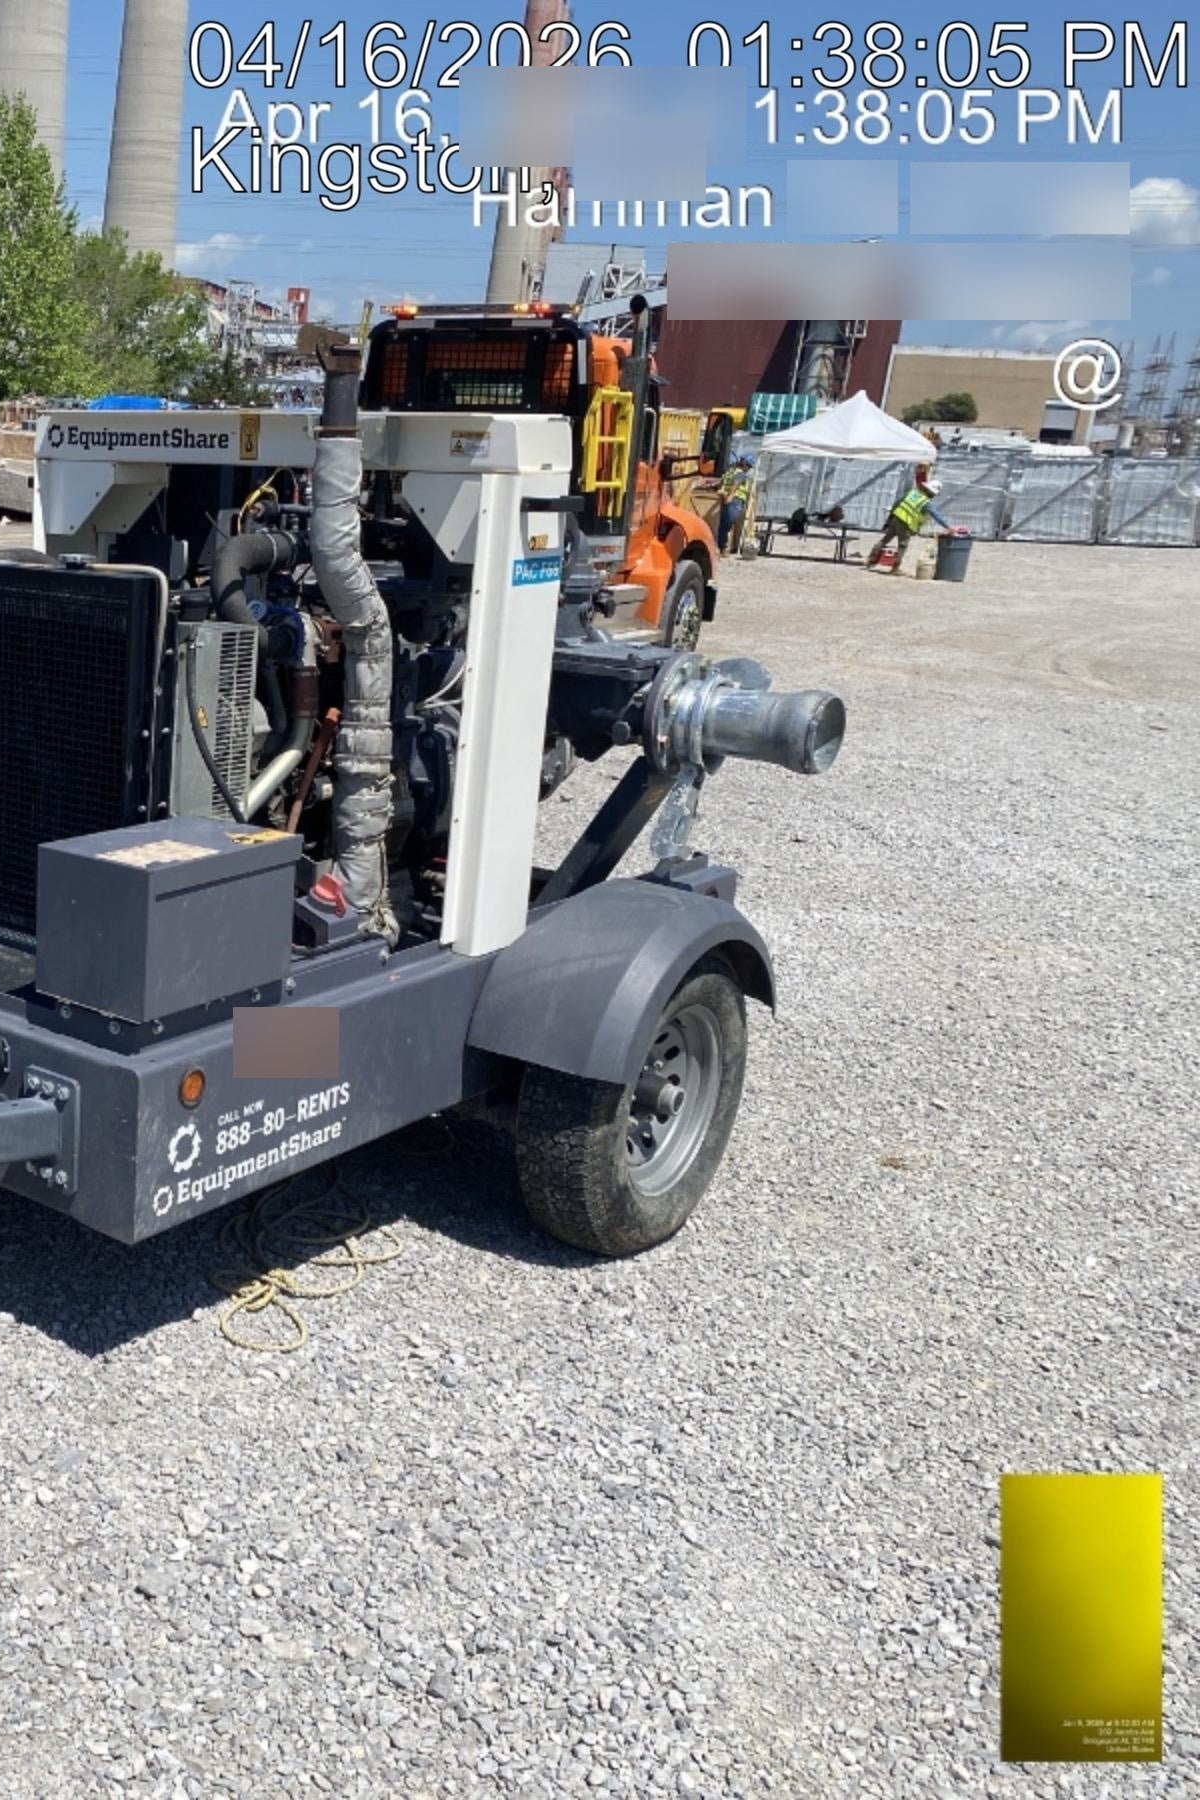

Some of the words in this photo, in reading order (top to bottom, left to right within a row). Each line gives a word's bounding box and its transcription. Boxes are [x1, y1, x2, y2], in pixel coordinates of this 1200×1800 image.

[67, 425, 230, 450] EquipmentShare
[217, 1109, 240, 1127] CALL
[177, 1120, 342, 1205] EquipmentShare
